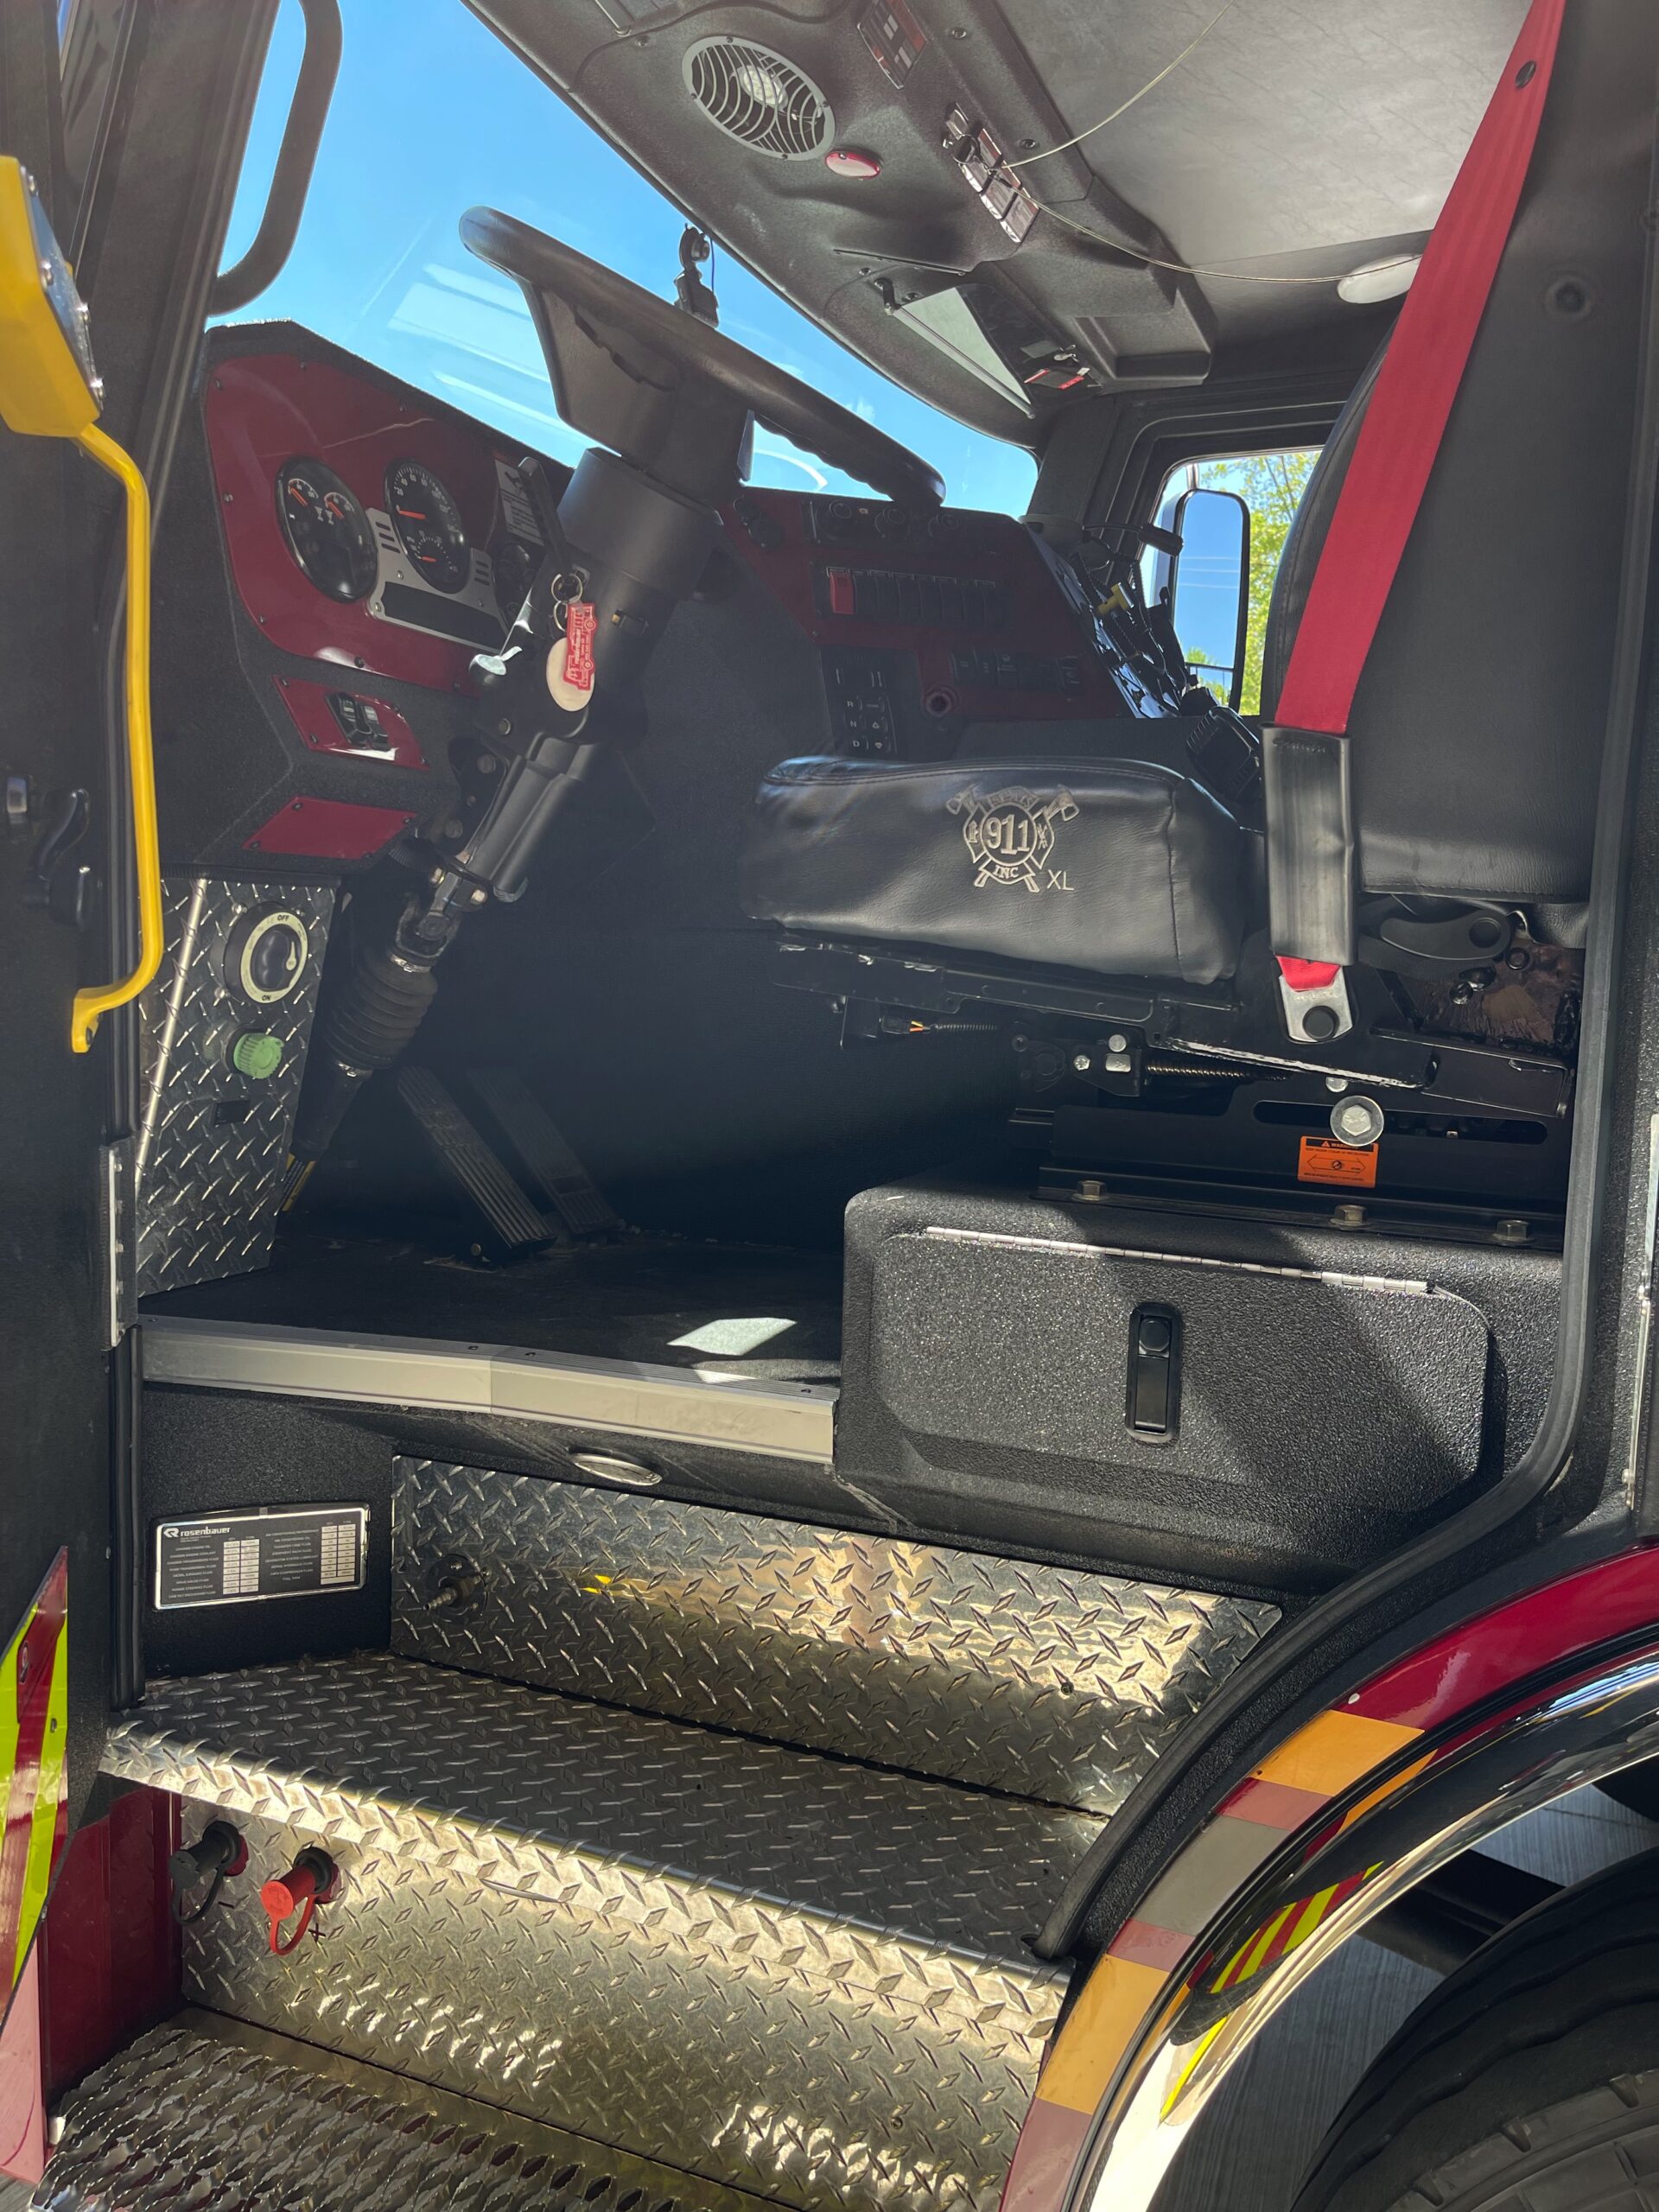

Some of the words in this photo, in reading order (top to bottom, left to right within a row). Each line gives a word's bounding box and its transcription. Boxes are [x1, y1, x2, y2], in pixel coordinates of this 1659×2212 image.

[986, 814, 1030, 855] 911
[993, 866, 1019, 879] INC
[1047, 869, 1075, 891] XL
[180, 1526, 231, 1537] rosenbauer
